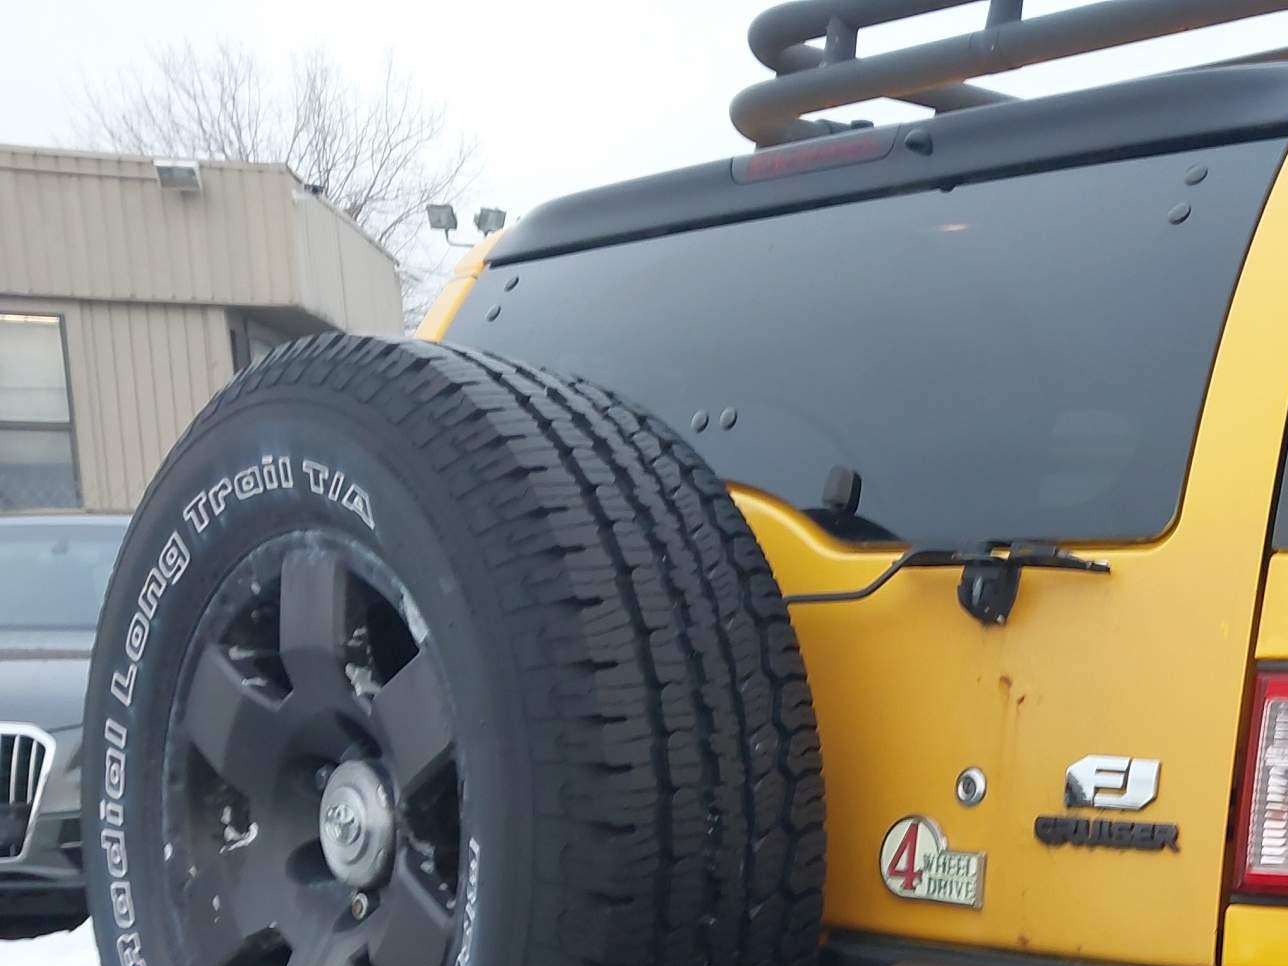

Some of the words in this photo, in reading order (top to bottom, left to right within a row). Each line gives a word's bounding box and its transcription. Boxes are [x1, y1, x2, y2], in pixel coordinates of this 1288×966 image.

[111, 530, 191, 706] Long
[183, 454, 294, 534] Trail
[1064, 753, 1162, 811] FJ
[887, 821, 924, 891] 4
[1034, 816, 1181, 853] CRUISER
[922, 852, 978, 878] WHEEL
[926, 876, 977, 901] DRIVE
